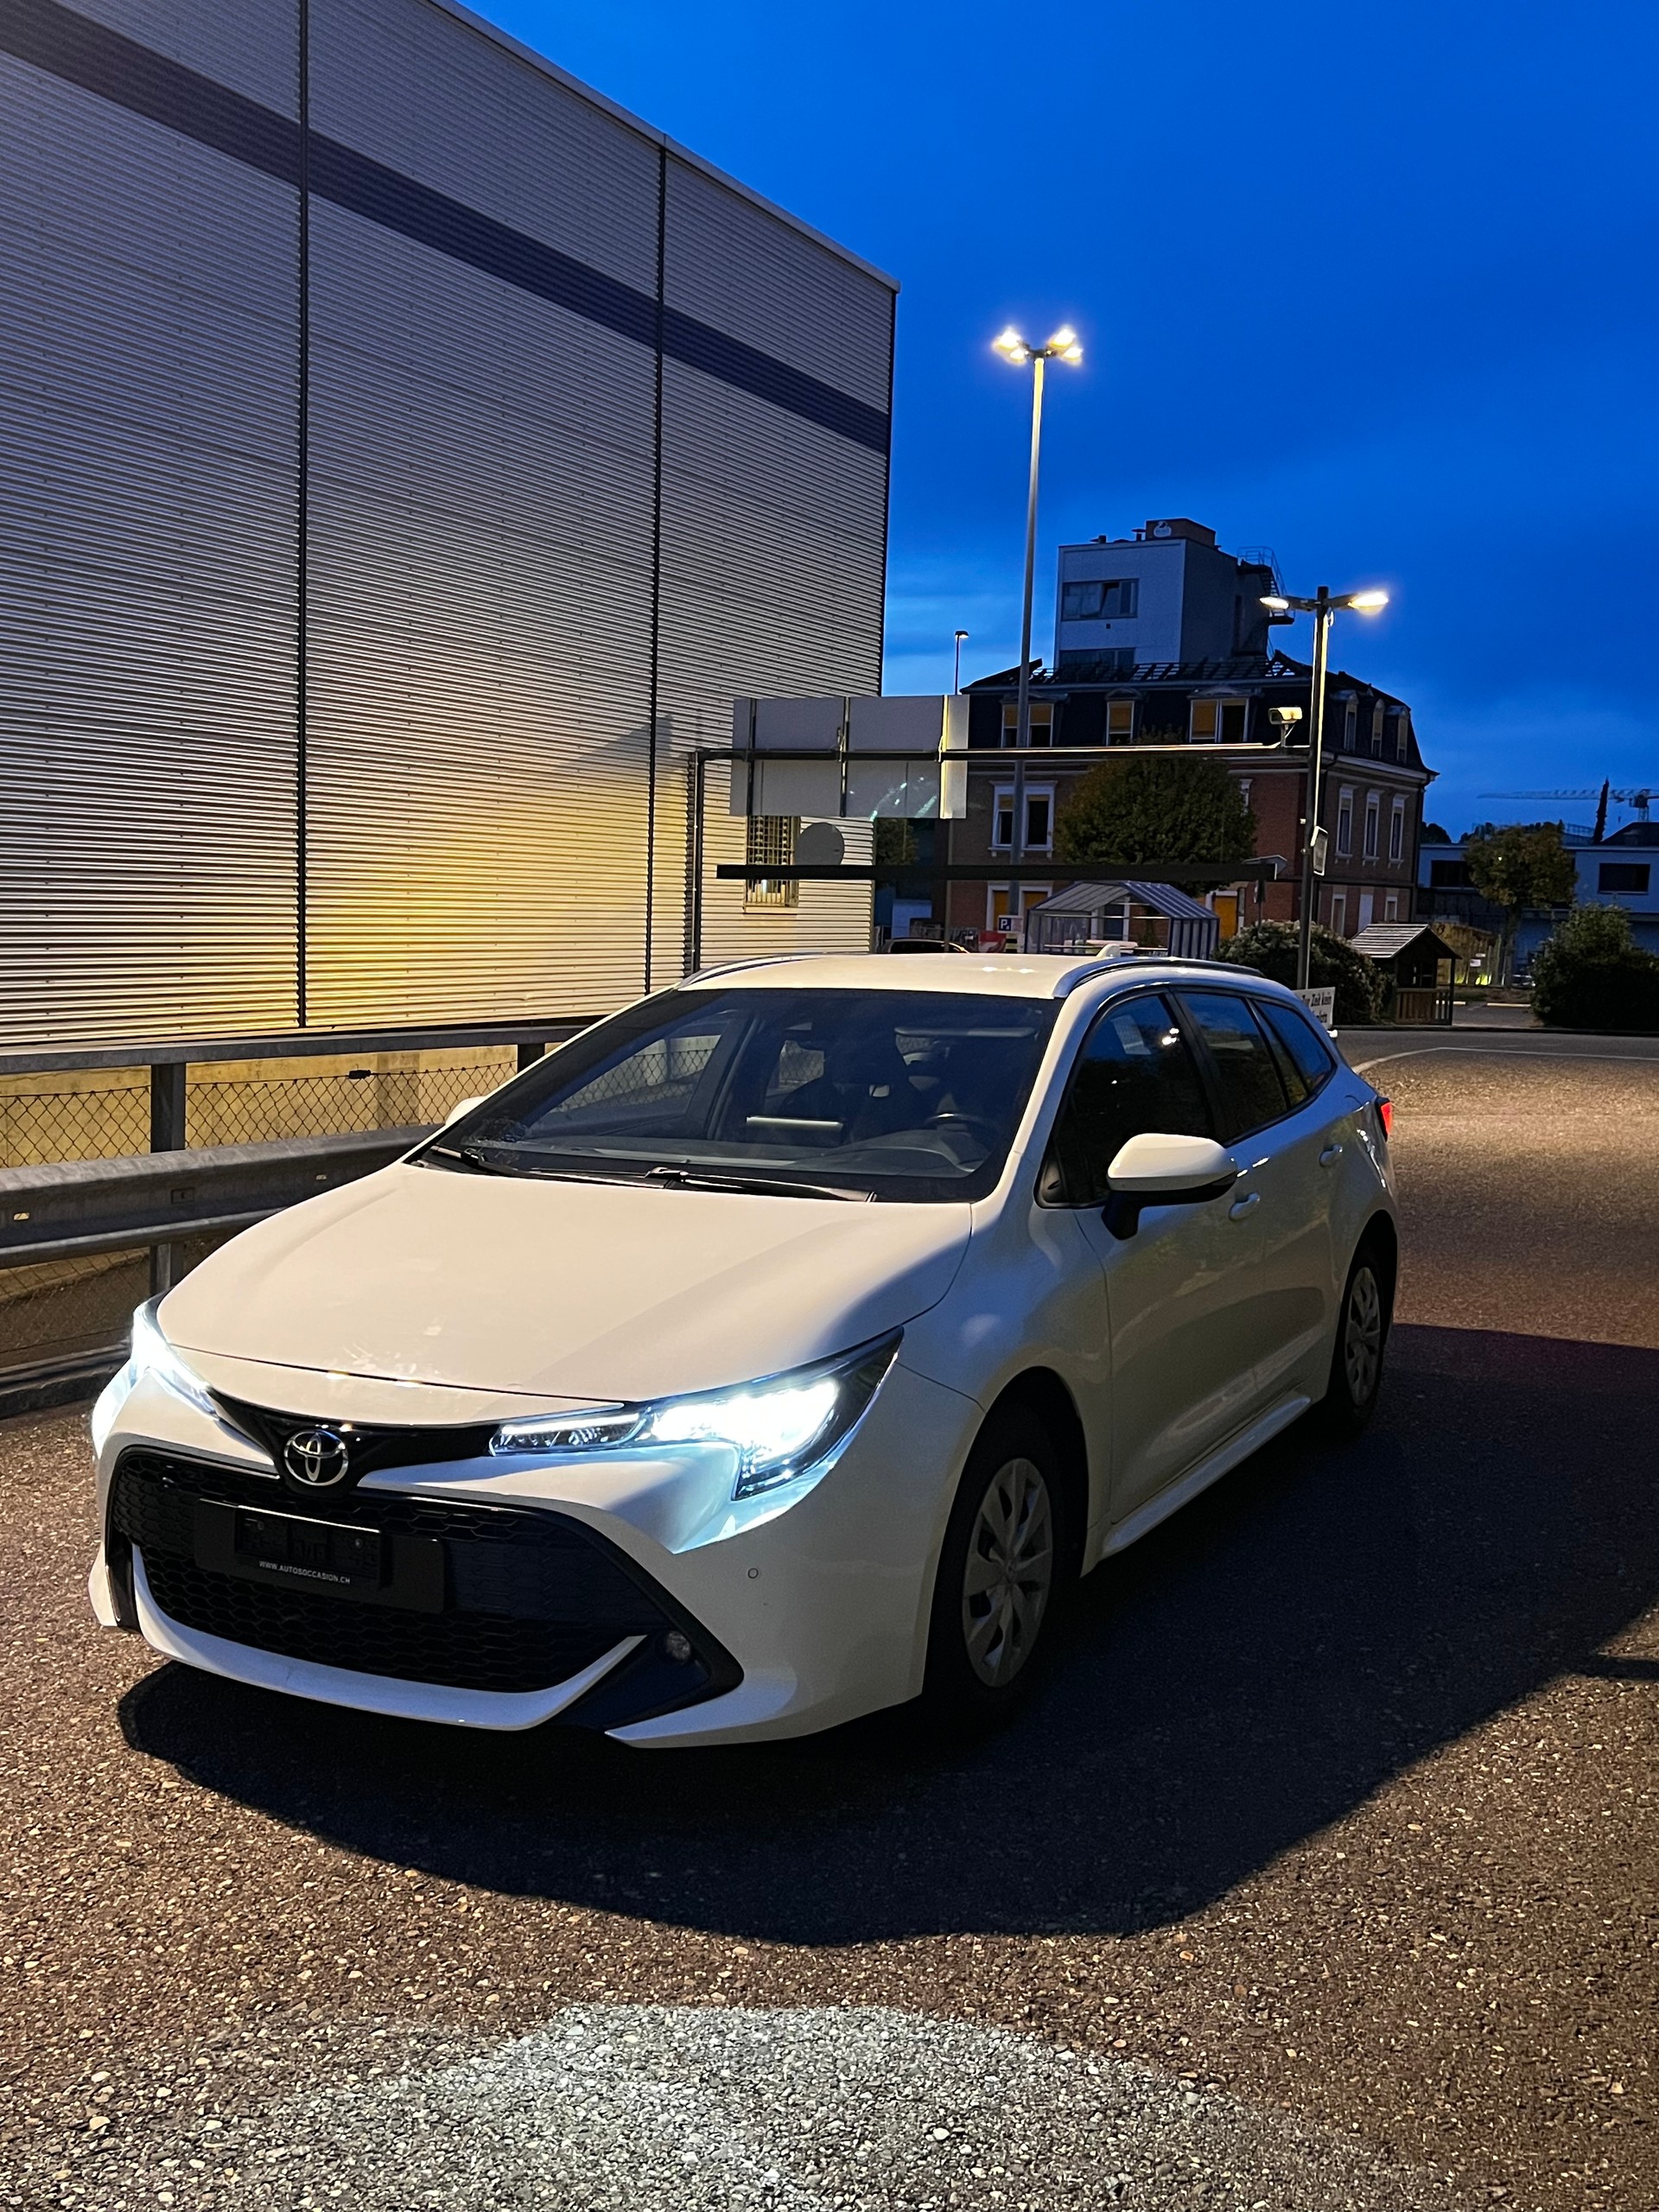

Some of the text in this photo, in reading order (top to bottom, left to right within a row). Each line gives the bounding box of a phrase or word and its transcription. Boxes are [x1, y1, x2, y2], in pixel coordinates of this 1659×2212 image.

[1001, 919, 1007, 930] P
[1311, 994, 1320, 1006] Zeit
[1322, 993, 1332, 1005] kein
[259, 1560, 350, 1584] WWW.AUTOSOCCASION.CH
